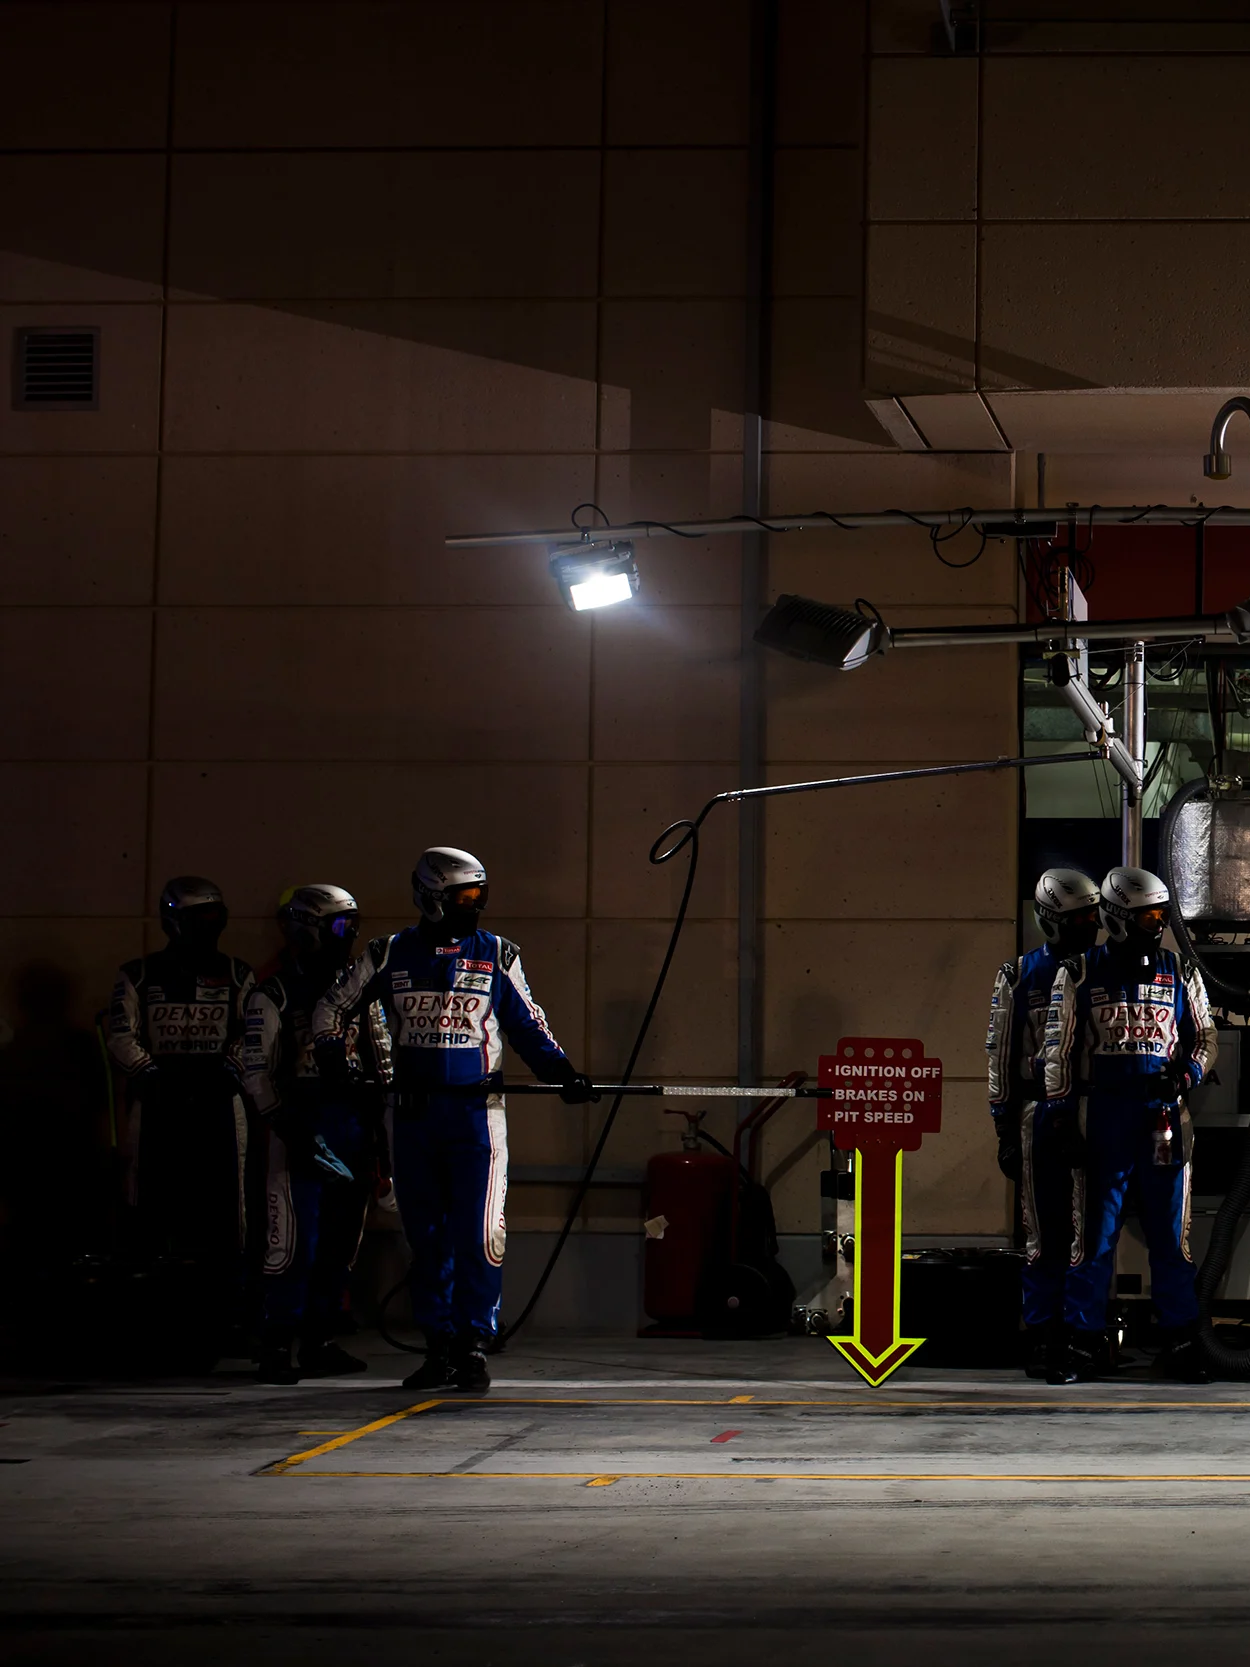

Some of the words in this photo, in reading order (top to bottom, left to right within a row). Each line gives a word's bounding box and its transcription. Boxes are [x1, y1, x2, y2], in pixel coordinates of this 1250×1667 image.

[1105, 901, 1137, 923] uvex
[467, 963, 493, 971] TOTAL
[403, 995, 480, 1013] DENSO
[153, 1006, 225, 1022] DENSO
[1100, 1006, 1169, 1023] DENSO
[407, 1016, 472, 1029] TOYOTA
[157, 1025, 220, 1036] TOYOTA
[1106, 1026, 1163, 1039] TOYOTA
[408, 1033, 470, 1044] HYBRID
[159, 1040, 218, 1051] HYBRID
[1103, 1042, 1162, 1053] HYBRID
[835, 1065, 906, 1078] IGNITION
[911, 1067, 940, 1078] OFF
[835, 1089, 898, 1101] BRAKES
[902, 1091, 925, 1102] ON
[834, 1111, 859, 1122] PIT
[864, 1112, 914, 1124] SPEED
[268, 1193, 280, 1246] DENSO
